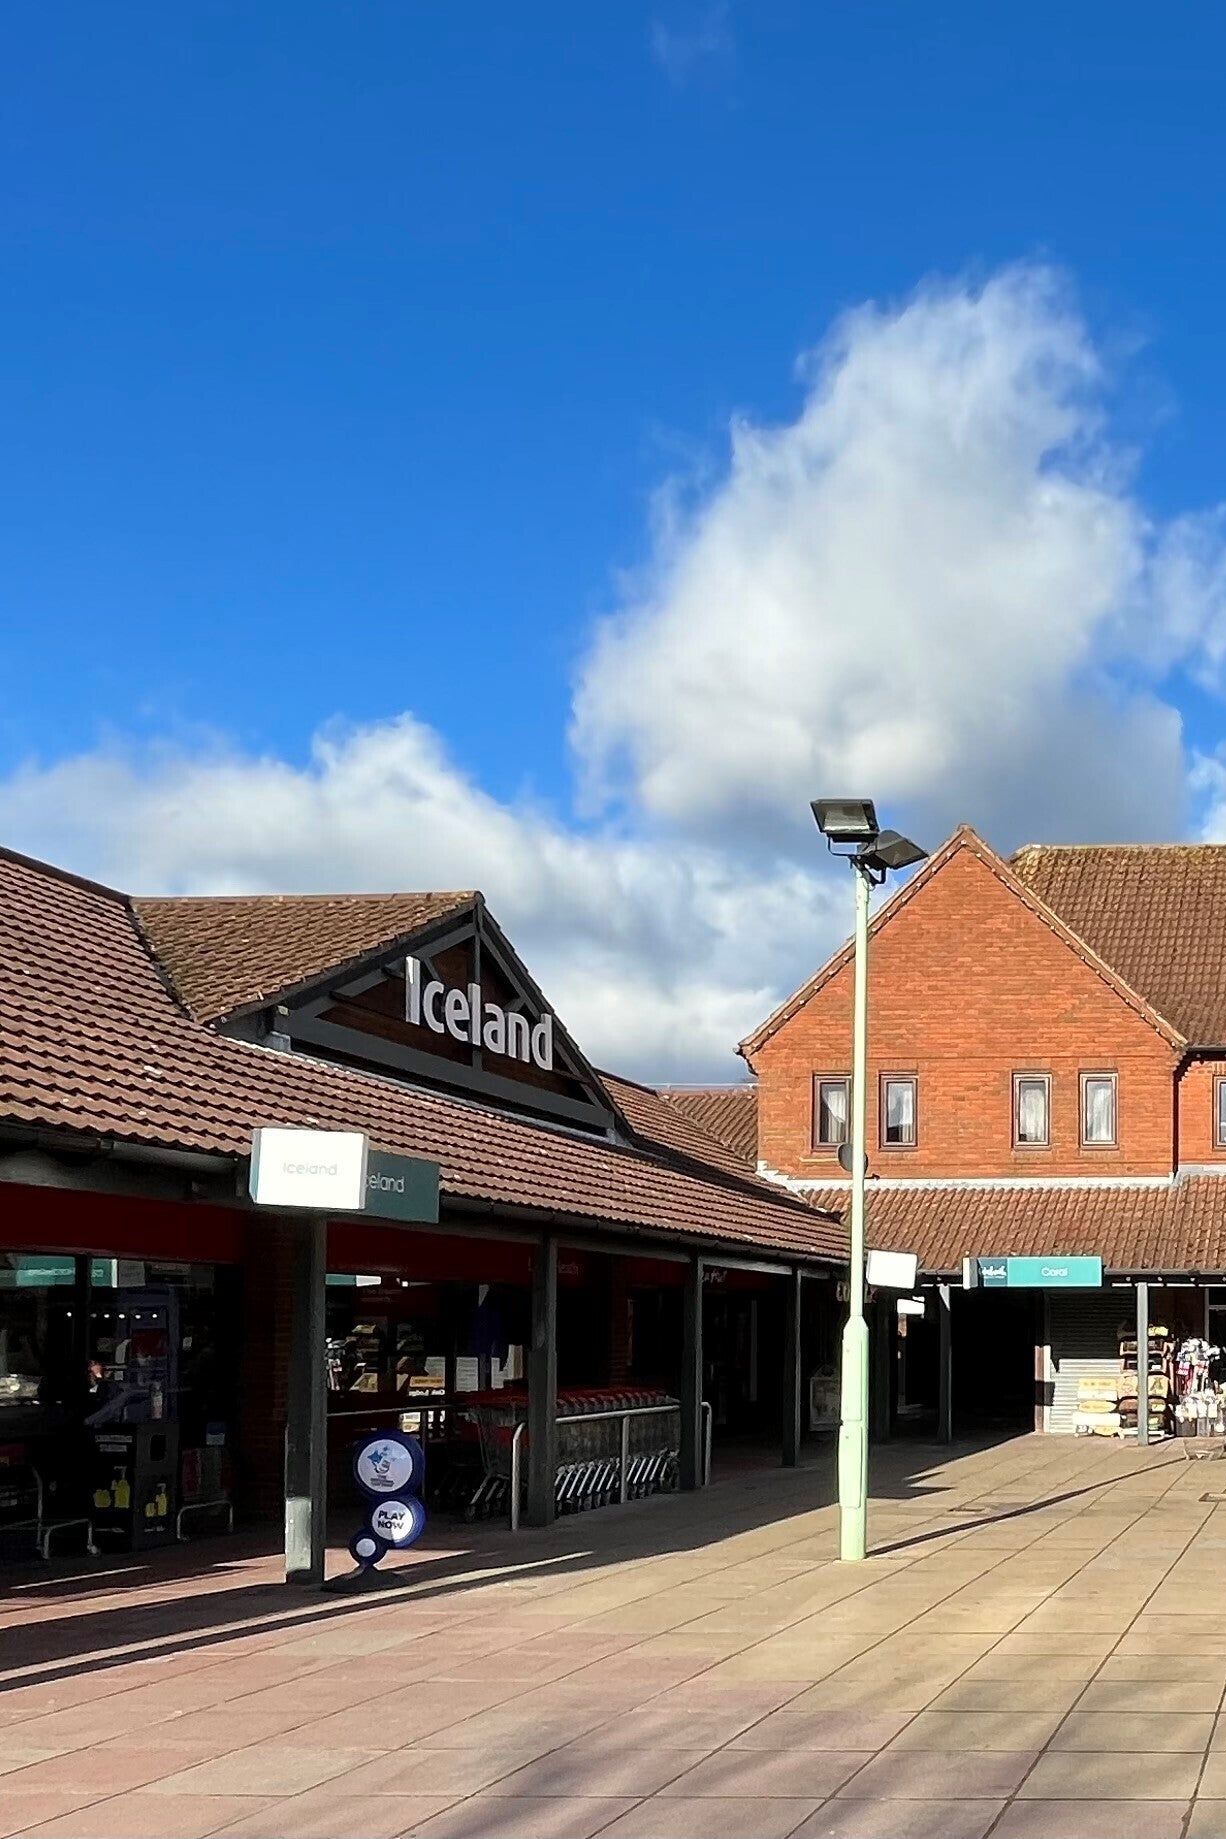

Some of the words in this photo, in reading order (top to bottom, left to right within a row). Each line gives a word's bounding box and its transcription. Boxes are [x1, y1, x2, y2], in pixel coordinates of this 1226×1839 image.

[405, 955, 553, 1071] Iceland
[283, 1162, 338, 1176] Iceland
[366, 1172, 405, 1193] eland
[1041, 1266, 1069, 1277] Coral
[378, 1510, 406, 1520] PLAY
[377, 1520, 404, 1530] NOW
